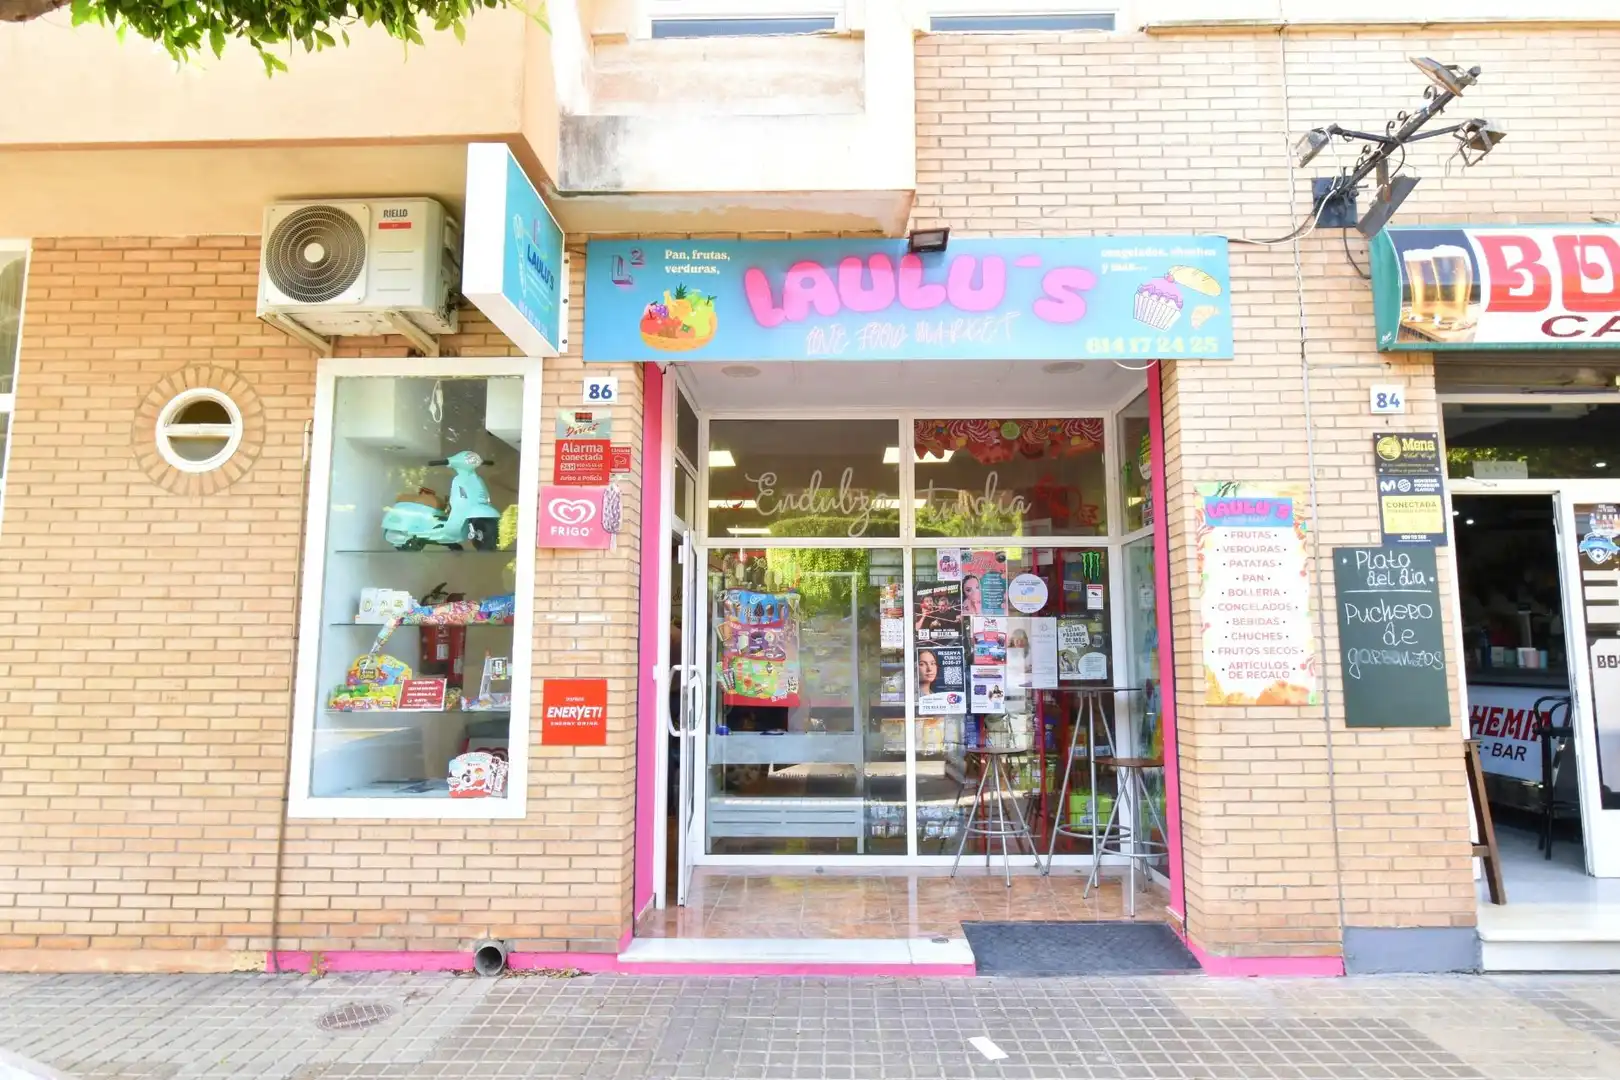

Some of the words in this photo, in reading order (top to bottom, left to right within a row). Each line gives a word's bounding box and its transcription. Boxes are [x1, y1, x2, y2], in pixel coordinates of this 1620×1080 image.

[383, 209, 408, 218] RIELLO
[665, 250, 690, 261] Pan,
[691, 249, 731, 261] frutas,
[527, 244, 555, 293] LAULU'S
[665, 263, 721, 275] verduras,
[1101, 262, 1108, 274] y
[1085, 337, 1127, 354] 614
[1129, 337, 1153, 353] 17
[1157, 337, 1185, 353] 24
[1190, 337, 1219, 353] 25
[588, 384, 613, 399] 86
[1376, 392, 1400, 409] 84
[561, 442, 603, 453] Alarma
[1402, 438, 1436, 452] Mena
[561, 453, 603, 461] conectada
[745, 467, 895, 537] Endulza
[551, 526, 589, 537] FRIGO
[1230, 531, 1272, 539] FRUTAS
[1222, 545, 1281, 553] VERDURAS
[1229, 560, 1276, 568] PATATAS
[1355, 550, 1411, 570] Plato
[1242, 574, 1265, 582] PAN
[1367, 569, 1395, 586] del
[1232, 618, 1280, 626] BEBIDAS
[1231, 632, 1283, 640] CHUCHES
[1383, 622, 1418, 646] de
[1218, 647, 1261, 655] FRUTOS
[1263, 647, 1299, 655] SECOS
[1228, 671, 1244, 679] DE
[1246, 671, 1290, 679] REGALO
[547, 705, 602, 720] ENERYETI
